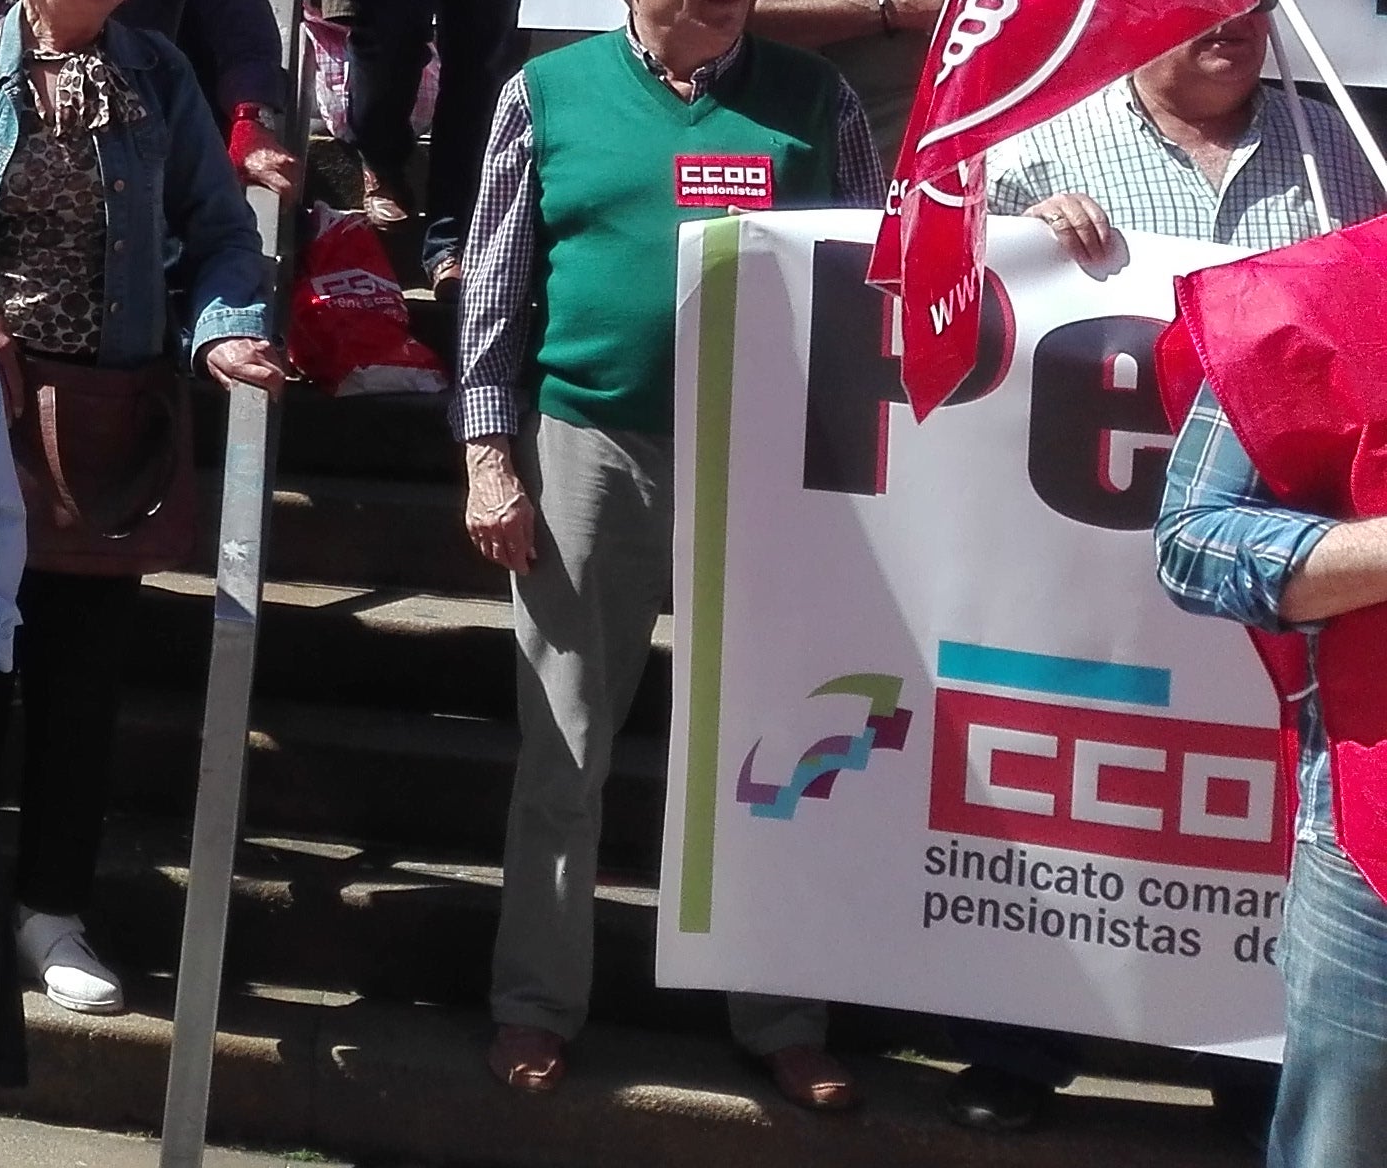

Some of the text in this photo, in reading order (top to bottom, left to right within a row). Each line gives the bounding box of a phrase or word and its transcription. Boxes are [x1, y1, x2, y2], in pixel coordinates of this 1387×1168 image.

[680, 166, 767, 185] CCOO
[681, 184, 767, 197] pensionistas
[924, 839, 1287, 920] sindicato comar
[922, 888, 1202, 958] pensionistas
